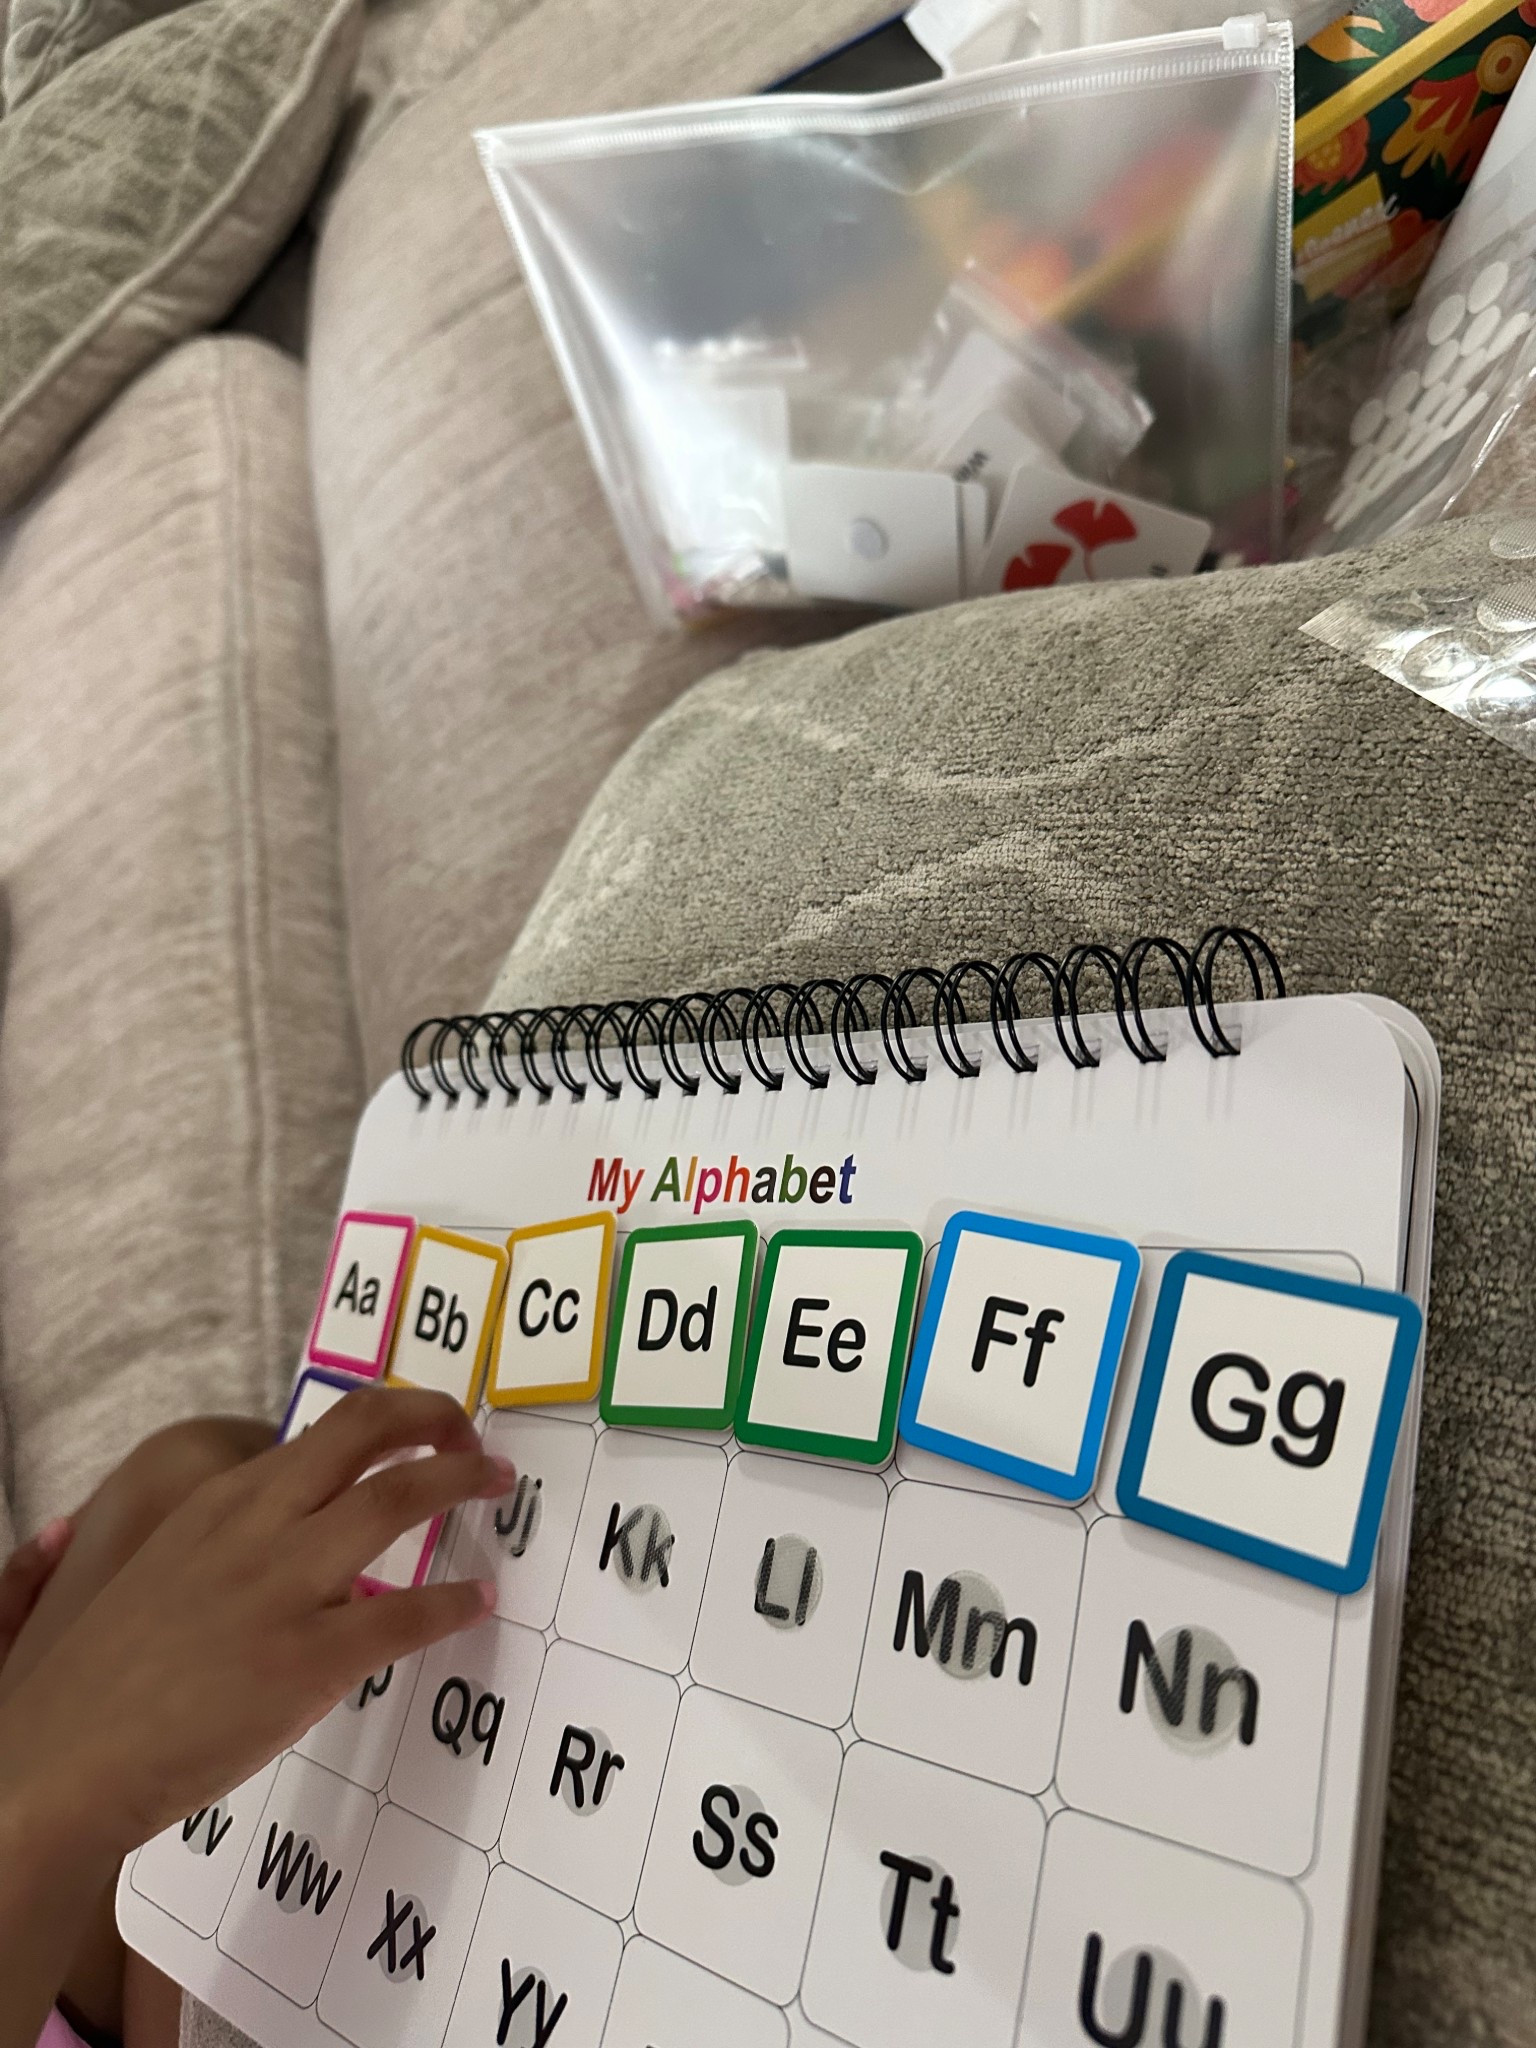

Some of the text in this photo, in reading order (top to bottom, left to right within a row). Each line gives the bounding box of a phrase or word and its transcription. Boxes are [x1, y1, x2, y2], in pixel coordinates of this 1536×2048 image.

[588, 1154, 857, 1215] My Alphabet
[334, 1262, 380, 1316] Aa
[414, 1285, 468, 1353] Bb
[518, 1278, 580, 1338] Cc
[637, 1285, 718, 1352] Dd
[782, 1297, 866, 1373] Ee
[971, 1296, 1065, 1388] Ff
[1190, 1352, 1346, 1469] Gg
[494, 1474, 542, 1558] Jj
[599, 1502, 676, 1588] Kk
[754, 1537, 818, 1627] Ll
[892, 1569, 1038, 1687] Mm
[431, 1676, 505, 1766] Qq
[1119, 1619, 1260, 1747] Nn
[549, 1724, 625, 1809] Rr
[257, 1822, 343, 1916] Ww
[692, 1784, 779, 1878] Ss
[366, 1888, 437, 1981] Xx
[879, 1850, 961, 1975] Tt
[496, 1958, 568, 2048] Yy
